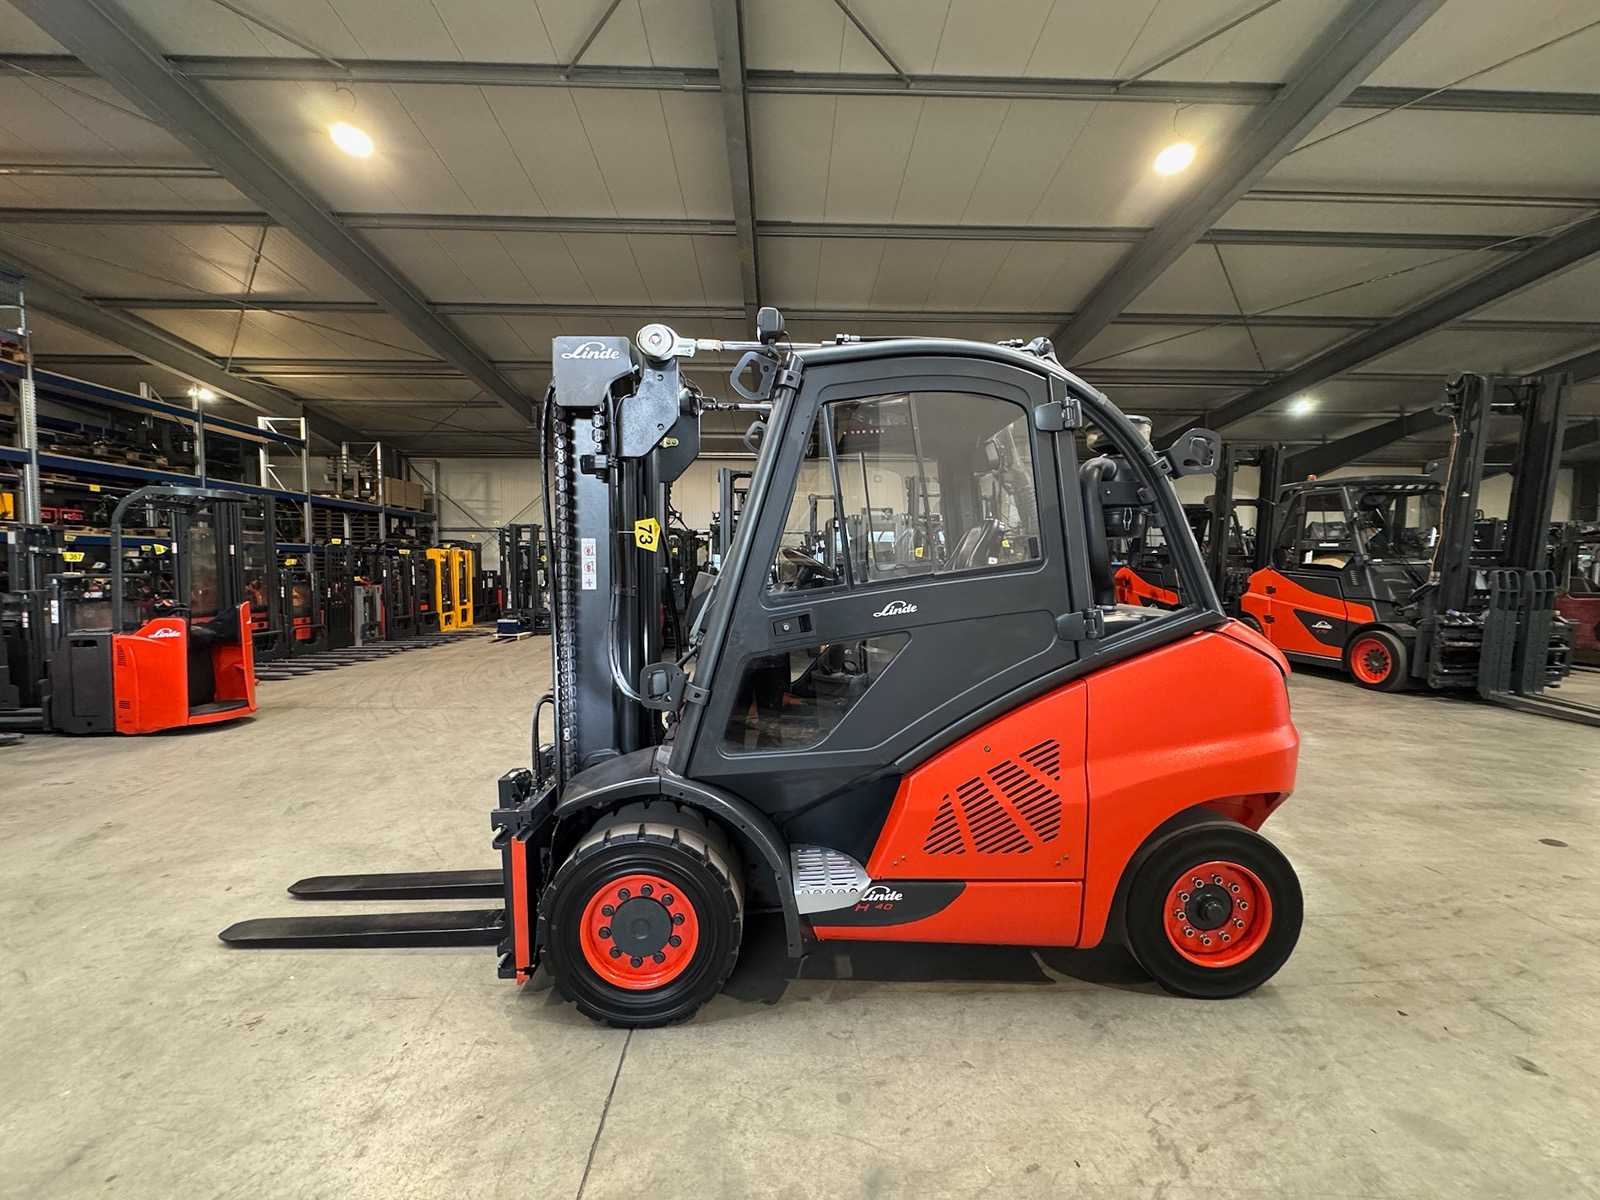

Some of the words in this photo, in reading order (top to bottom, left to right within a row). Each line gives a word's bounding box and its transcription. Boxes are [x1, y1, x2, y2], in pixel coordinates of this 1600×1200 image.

[561, 341, 620, 359] Linde
[638, 524, 653, 544] 73
[872, 600, 918, 617] Linde
[860, 885, 903, 901] Linde
[854, 903, 870, 911] H
